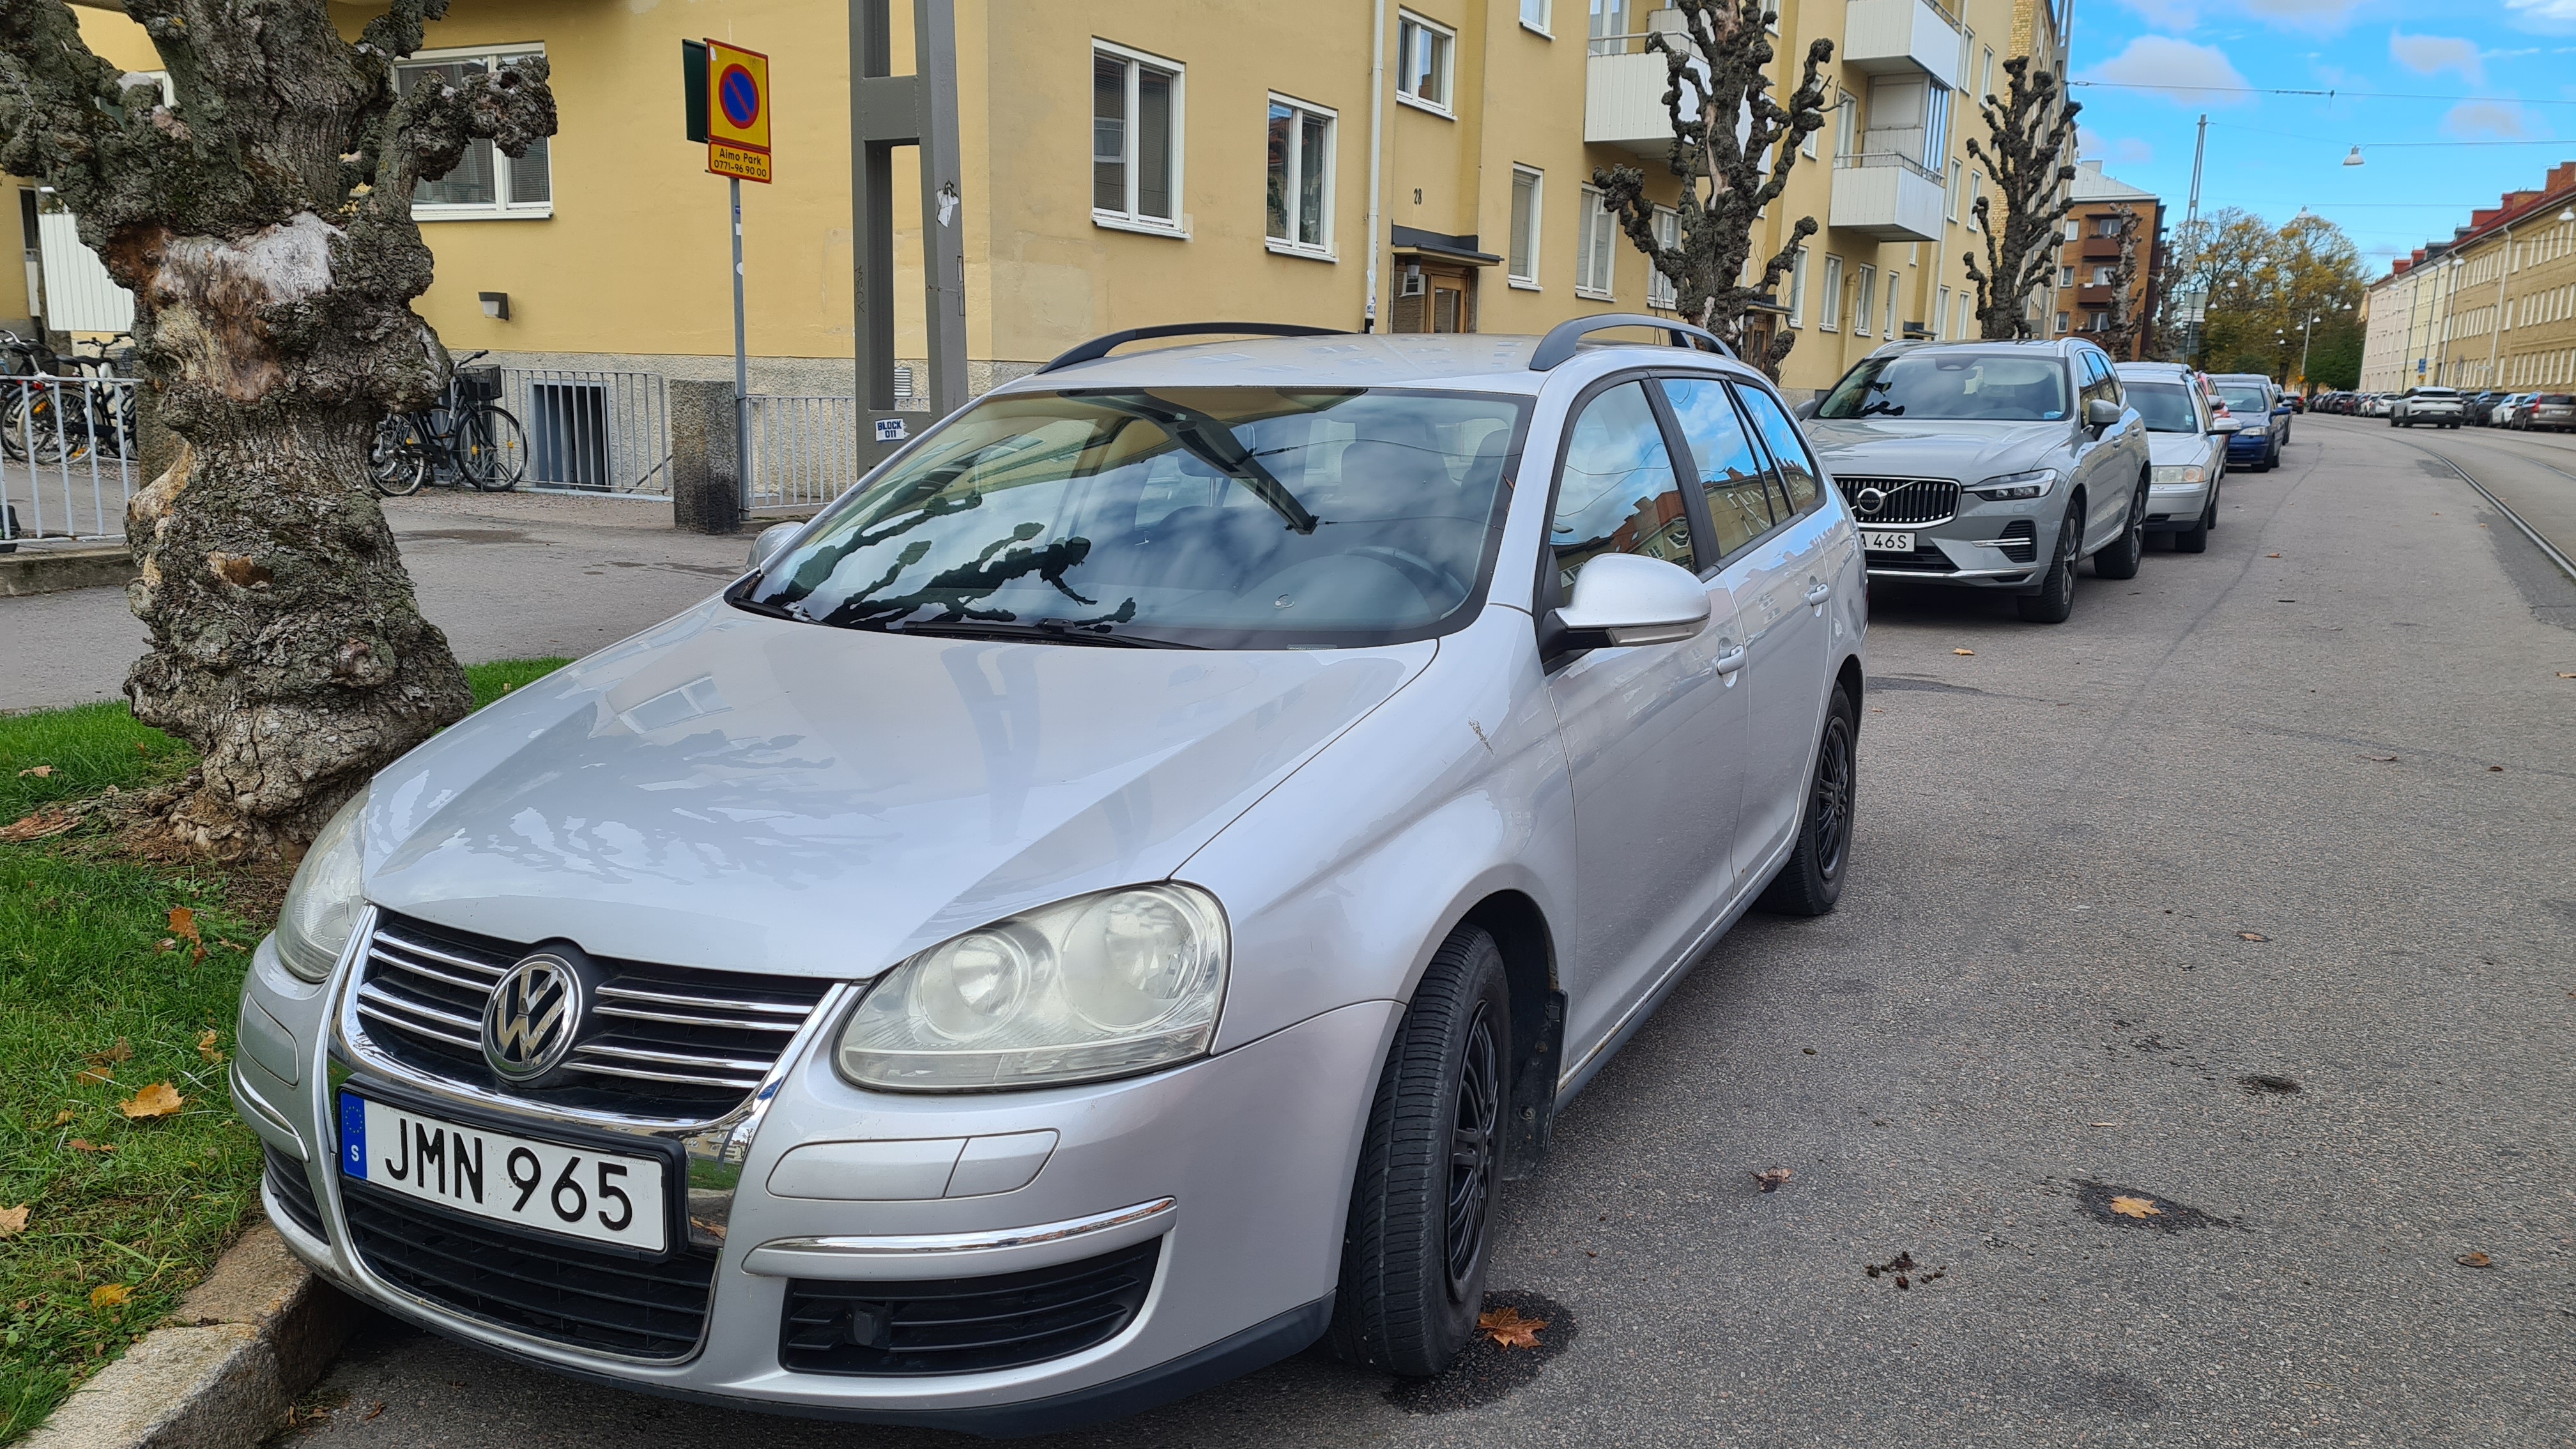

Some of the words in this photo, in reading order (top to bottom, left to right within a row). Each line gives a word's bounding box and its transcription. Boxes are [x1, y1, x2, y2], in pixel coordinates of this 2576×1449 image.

[719, 148, 740, 161] Aimo
[744, 153, 761, 165] Park
[714, 160, 743, 172] 0771-96
[746, 166, 755, 174] 90
[757, 168, 767, 177] 00
[1414, 188, 1422, 205] 28
[877, 420, 902, 431] BLOCK
[1873, 534, 1906, 549] 46S
[488, 961, 573, 1072] VW
[351, 1144, 359, 1162] S
[385, 1118, 484, 1204] JMN
[507, 1146, 633, 1232] 965
